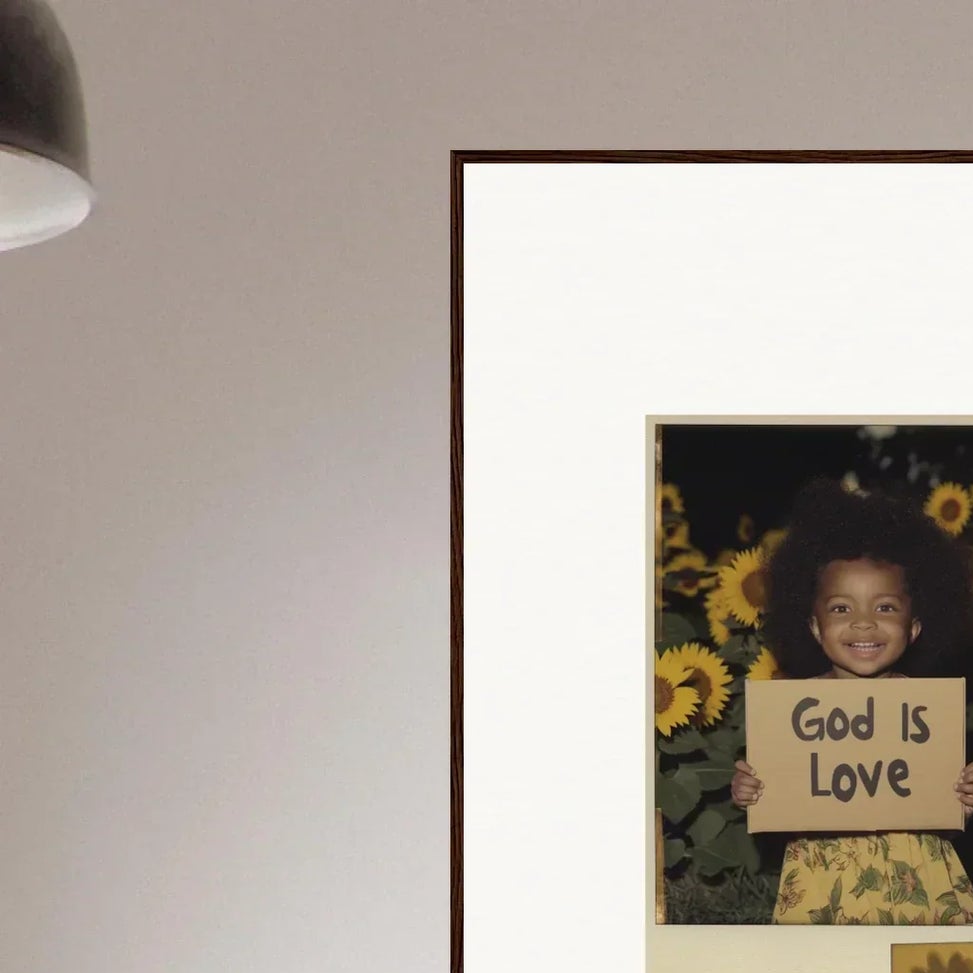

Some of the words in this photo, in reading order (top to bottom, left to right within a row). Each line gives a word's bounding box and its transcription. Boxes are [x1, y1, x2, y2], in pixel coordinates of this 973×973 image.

[791, 697, 874, 742] God
[902, 703, 931, 745] Is
[810, 752, 912, 803] Love
